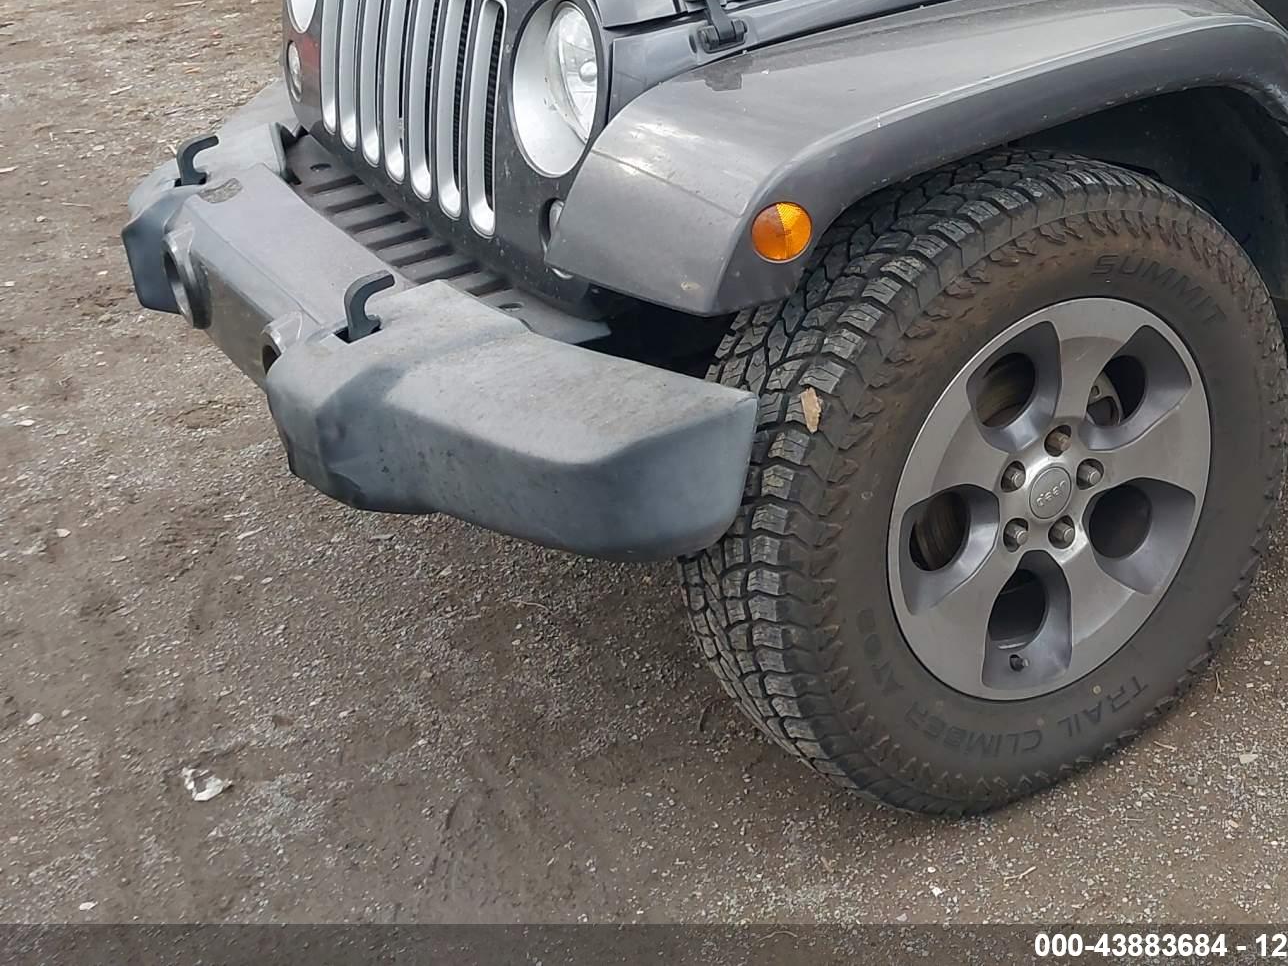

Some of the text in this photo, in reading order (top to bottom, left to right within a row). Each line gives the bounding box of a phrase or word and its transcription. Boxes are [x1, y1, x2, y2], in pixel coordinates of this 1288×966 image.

[1089, 253, 1227, 324] SUMMIT
[903, 701, 1042, 757] CLIMBER
[1056, 675, 1149, 738] TRAIL
